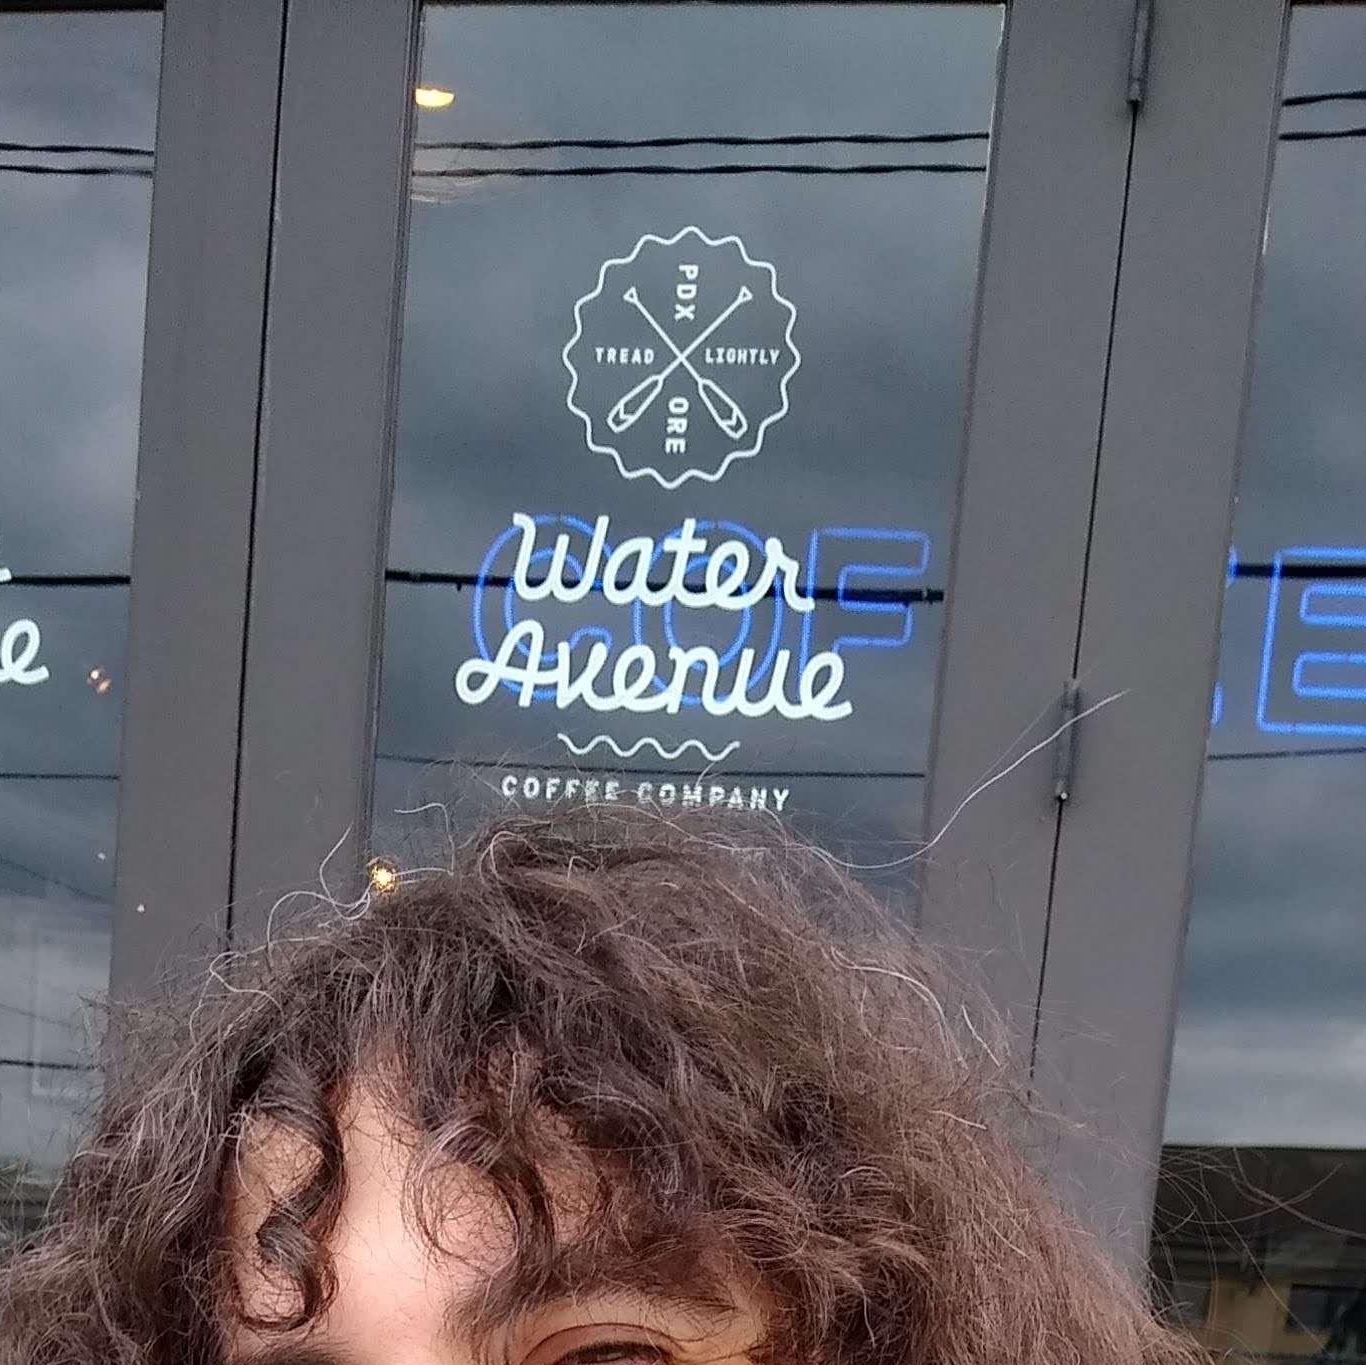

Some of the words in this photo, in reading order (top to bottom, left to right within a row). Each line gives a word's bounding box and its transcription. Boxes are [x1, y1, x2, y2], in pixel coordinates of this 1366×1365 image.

[675, 264, 698, 321] PDX
[596, 347, 655, 365] TREAD
[705, 347, 781, 366] LIGHTLY
[666, 397, 690, 455] ORE
[513, 512, 816, 613] Water
[455, 619, 853, 720] Avenue
[500, 774, 622, 803] COFFEE
[637, 783, 791, 812] COMPANY
